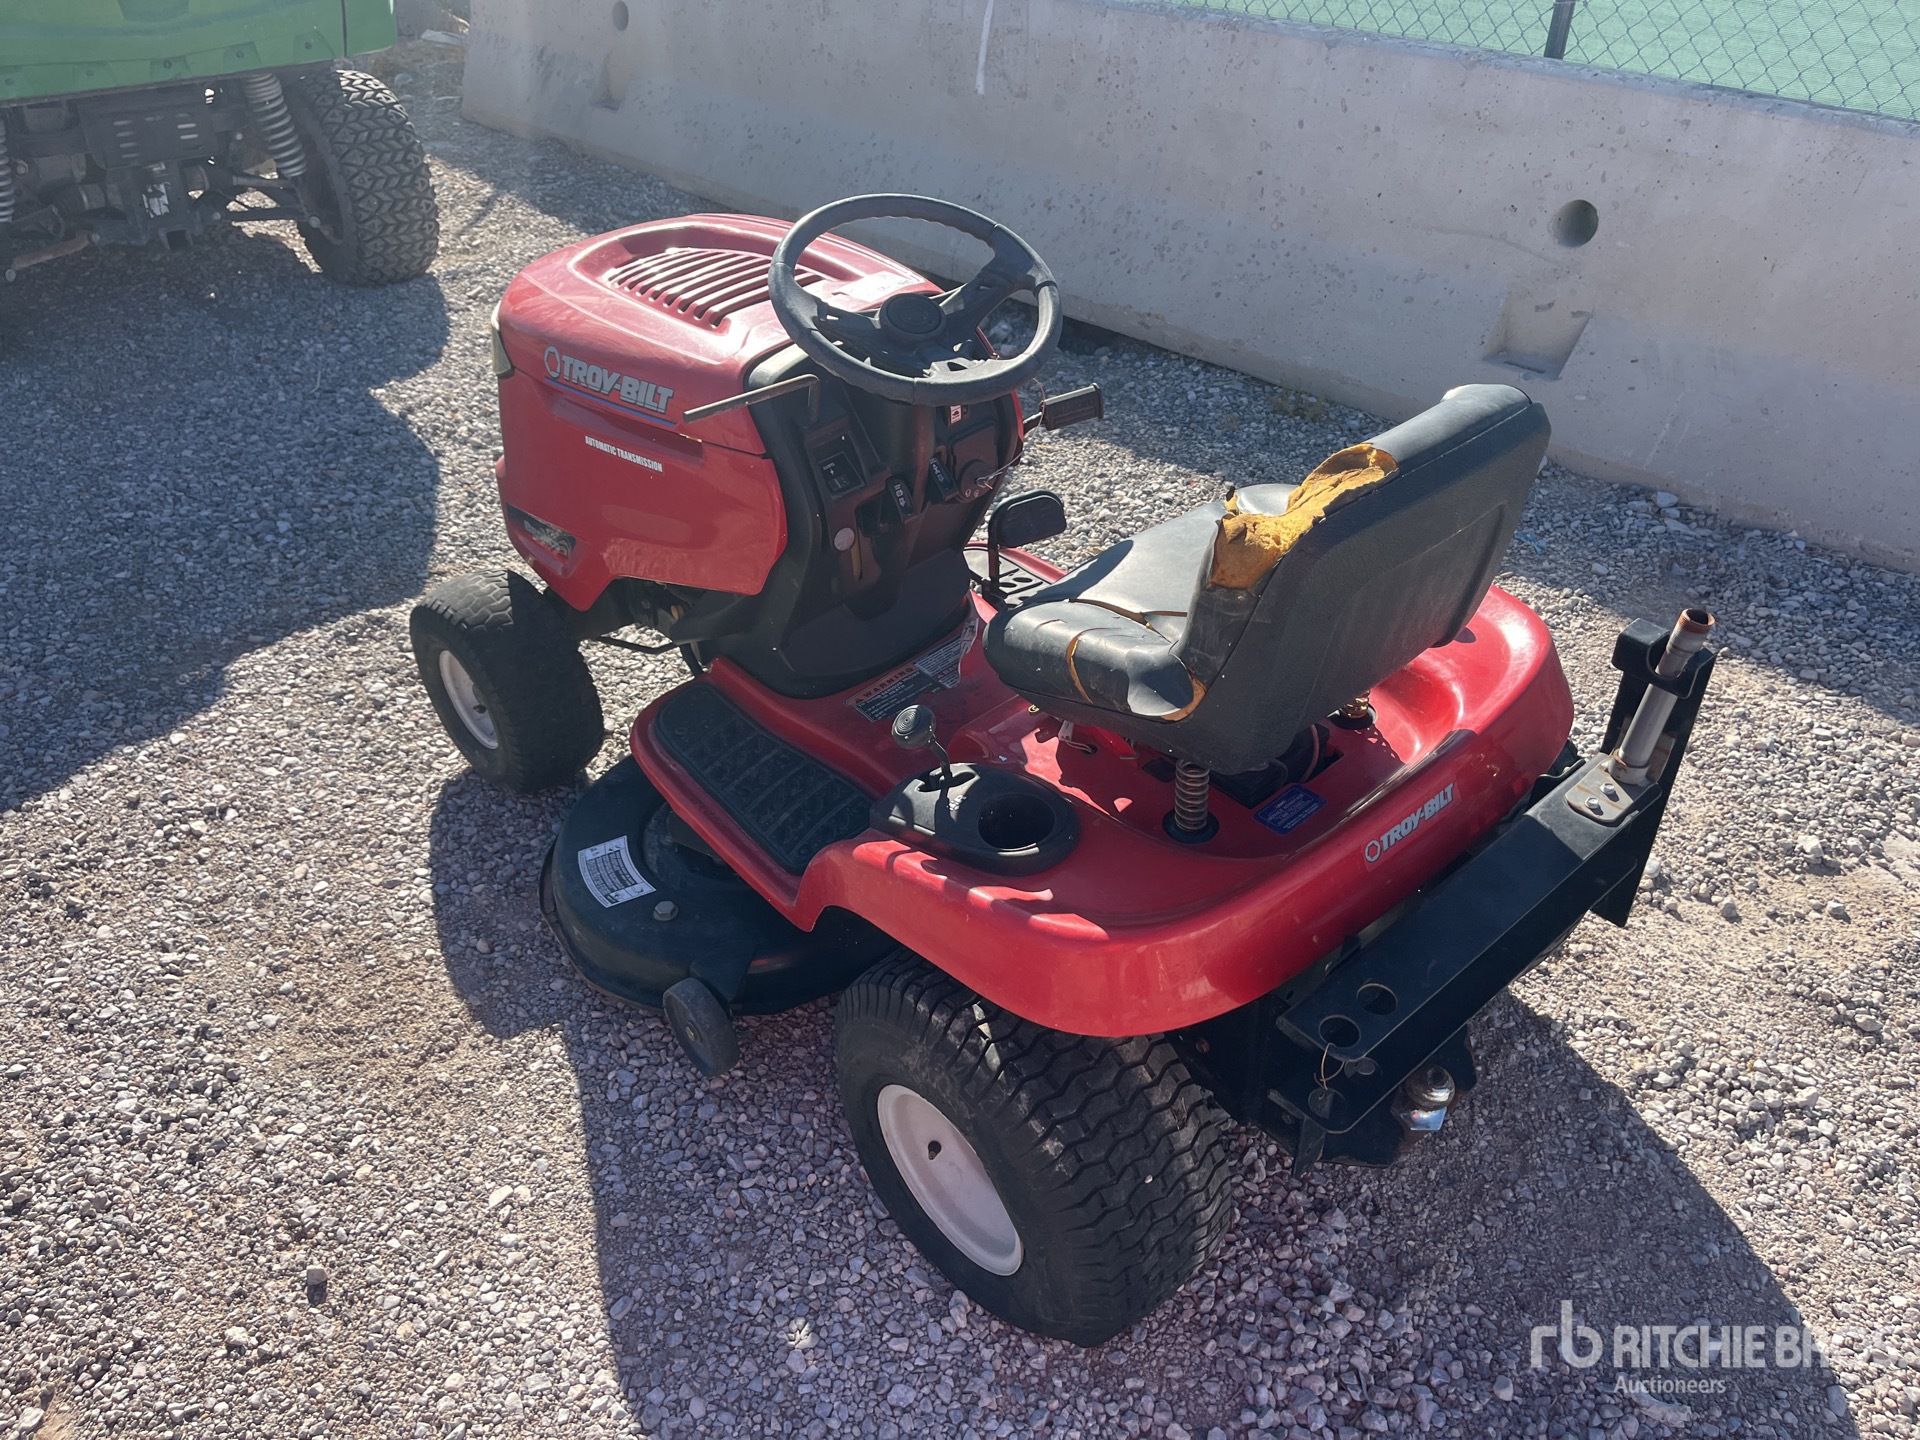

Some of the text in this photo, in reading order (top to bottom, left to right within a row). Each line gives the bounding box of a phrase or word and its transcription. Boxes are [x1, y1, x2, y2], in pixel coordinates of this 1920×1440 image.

[561, 354, 674, 414] TROY-BILT
[585, 435, 663, 473] AUTOMATIC TRANSMISSION
[863, 667, 914, 698] WARNING
[1380, 783, 1455, 851] TROY-BILT
